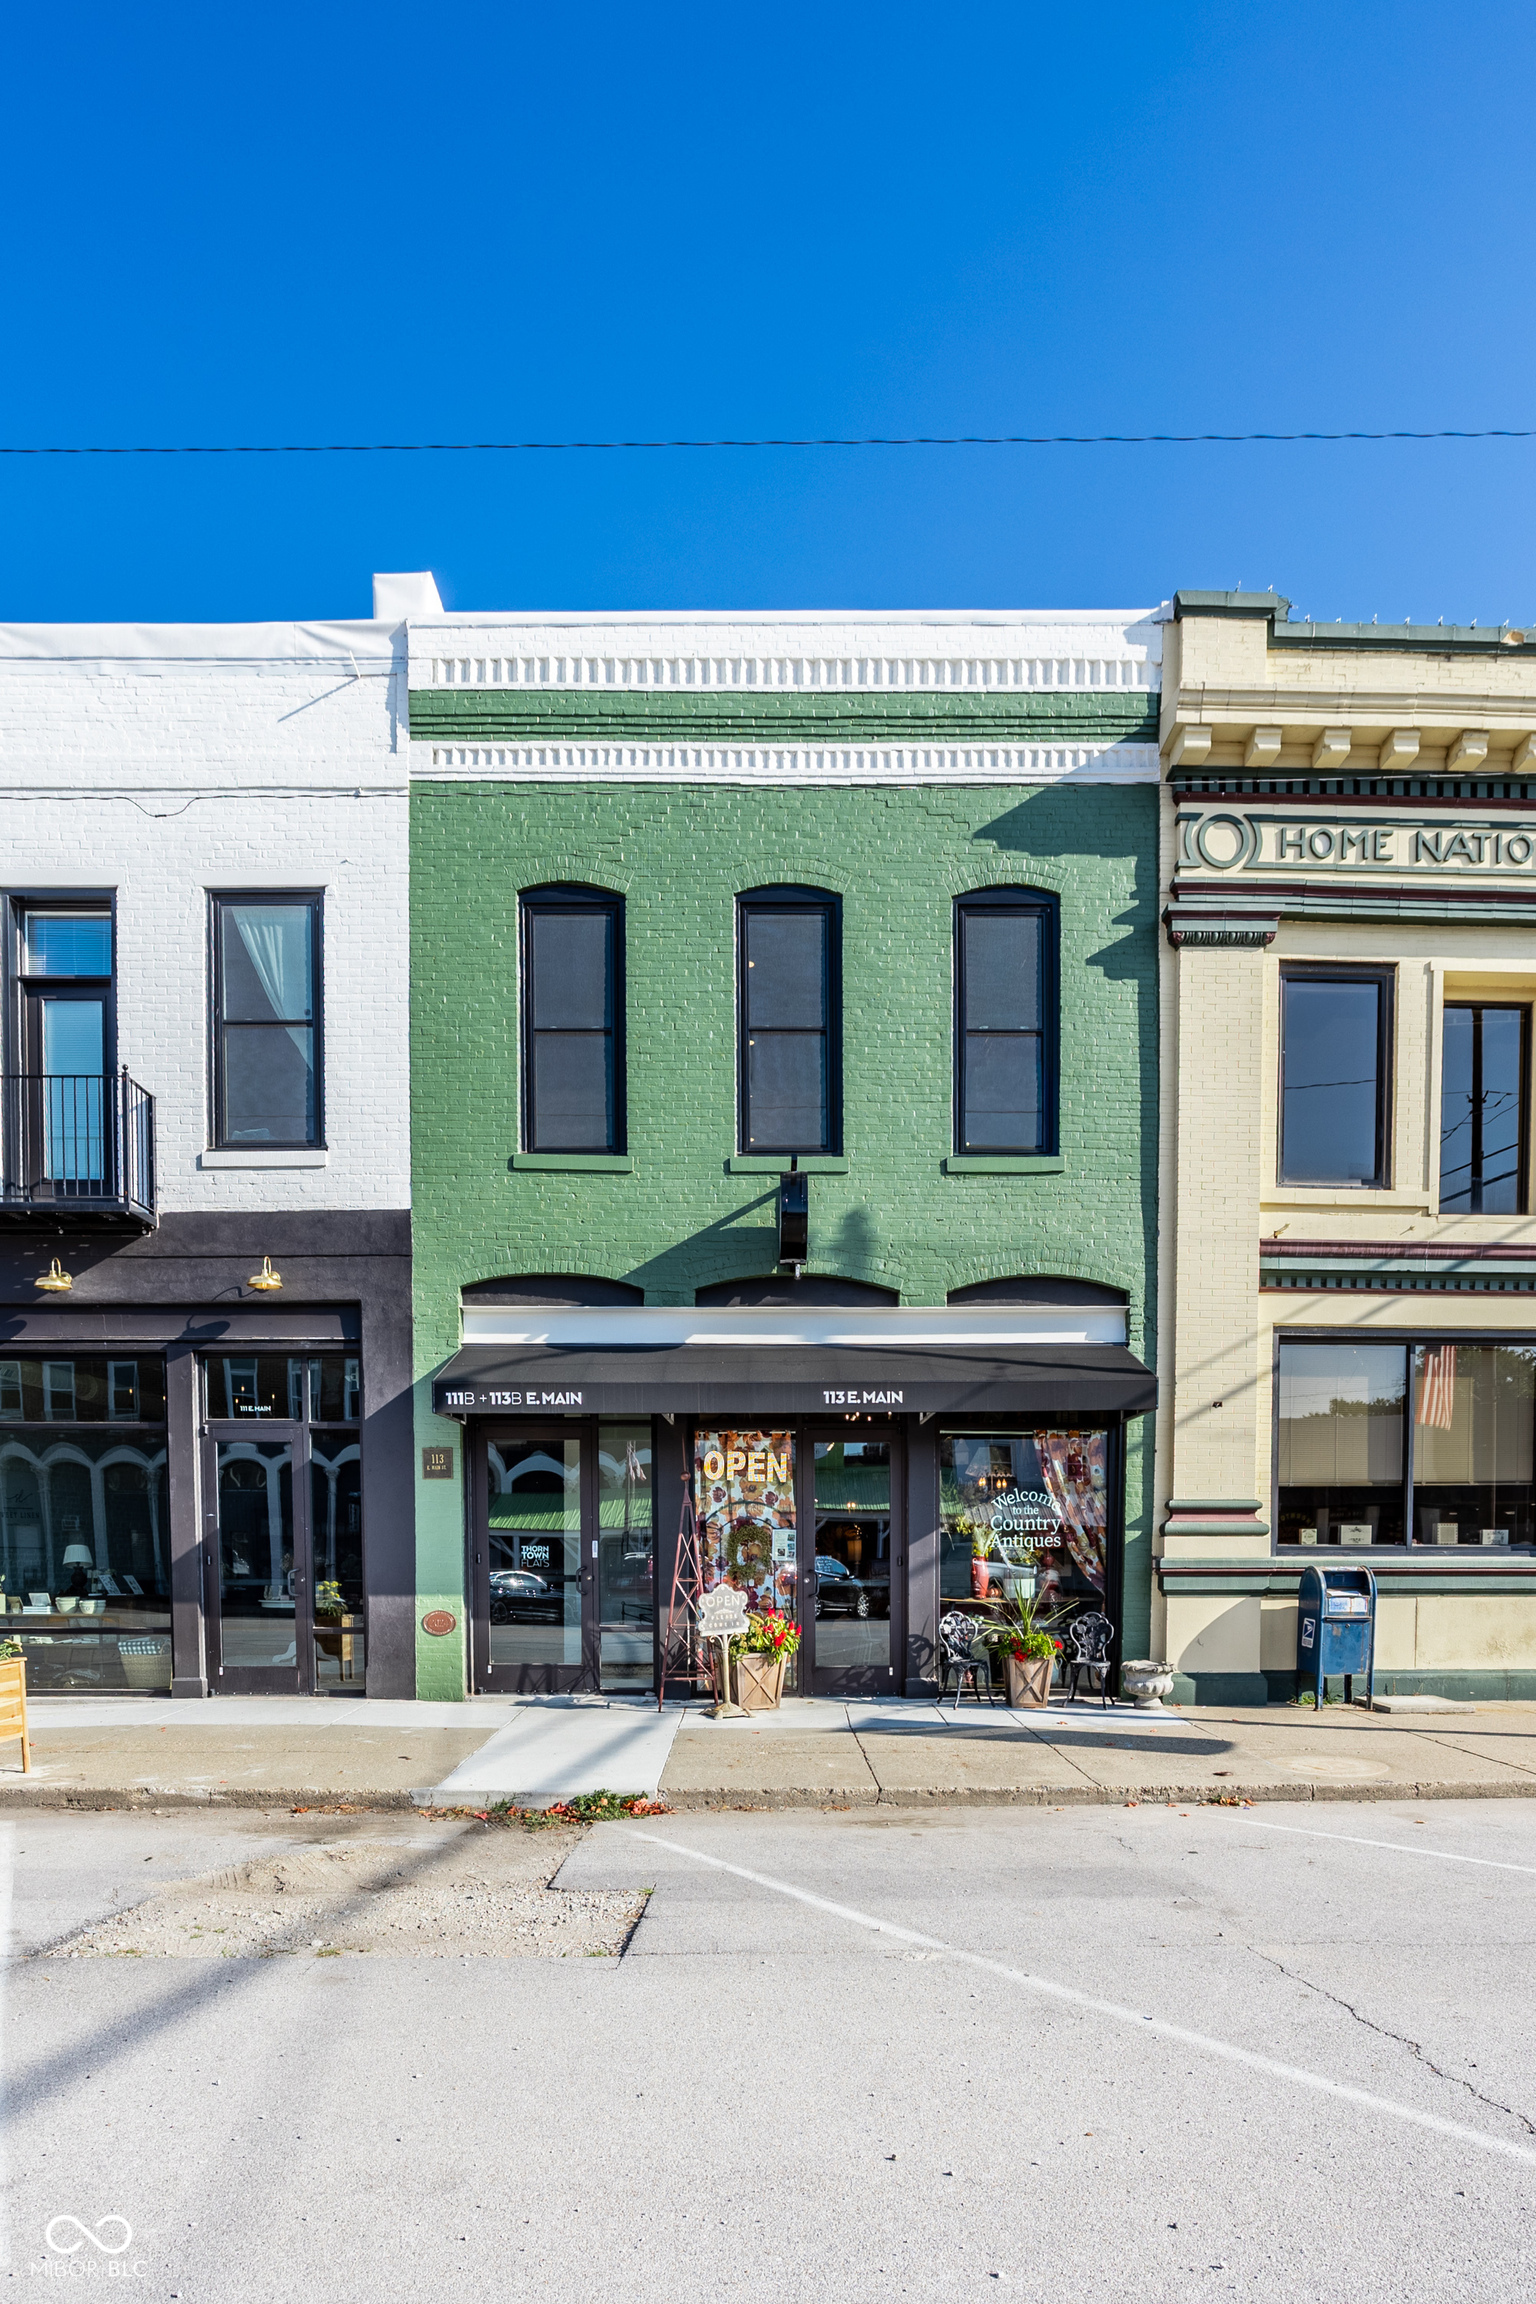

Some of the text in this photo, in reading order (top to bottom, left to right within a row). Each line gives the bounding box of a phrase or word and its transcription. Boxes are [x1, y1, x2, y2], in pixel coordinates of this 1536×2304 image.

[1280, 827, 1535, 864] HOME NATIO
[445, 1391, 475, 1405] 111B
[489, 1391, 522, 1405] 113B
[526, 1391, 540, 1405] E.
[542, 1391, 583, 1405] MAIN
[823, 1391, 904, 1404] 113 E. MAIN
[431, 1453, 444, 1464] 113
[703, 1450, 788, 1483] OPEN
[991, 1487, 1061, 1511] Welcome
[1012, 1505, 1039, 1515] to the
[990, 1515, 1061, 1535] Country
[990, 1531, 1061, 1552] Antiques
[521, 1559, 550, 1568] FLATS
[706, 1595, 740, 1607] OPEN
